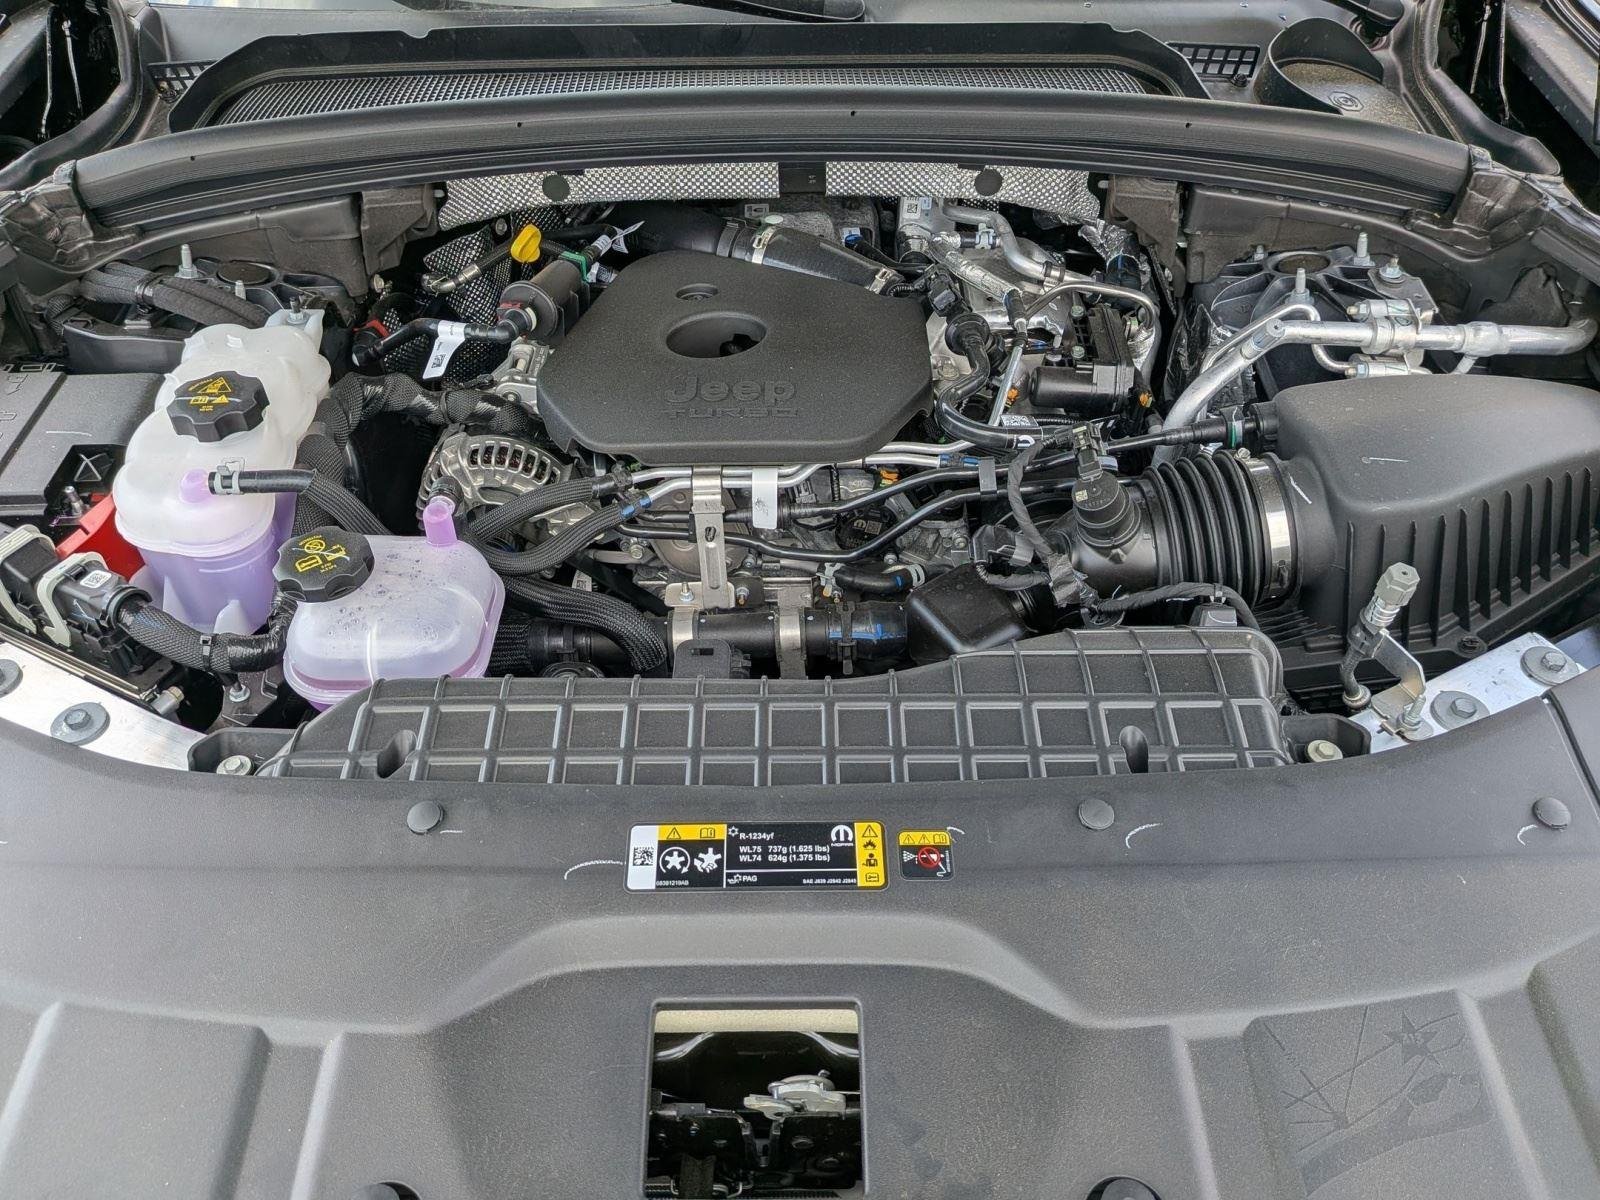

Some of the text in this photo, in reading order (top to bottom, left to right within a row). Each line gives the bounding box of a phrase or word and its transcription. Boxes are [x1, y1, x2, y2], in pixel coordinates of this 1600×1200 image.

[664, 375, 796, 406] Jeep
[662, 407, 798, 419] TURBO
[739, 832, 775, 841] R-1234yf
[739, 845, 830, 854] WL75 737g (1.625 lbs)
[739, 854, 831, 863] WL74 624g (1.375 lbs)
